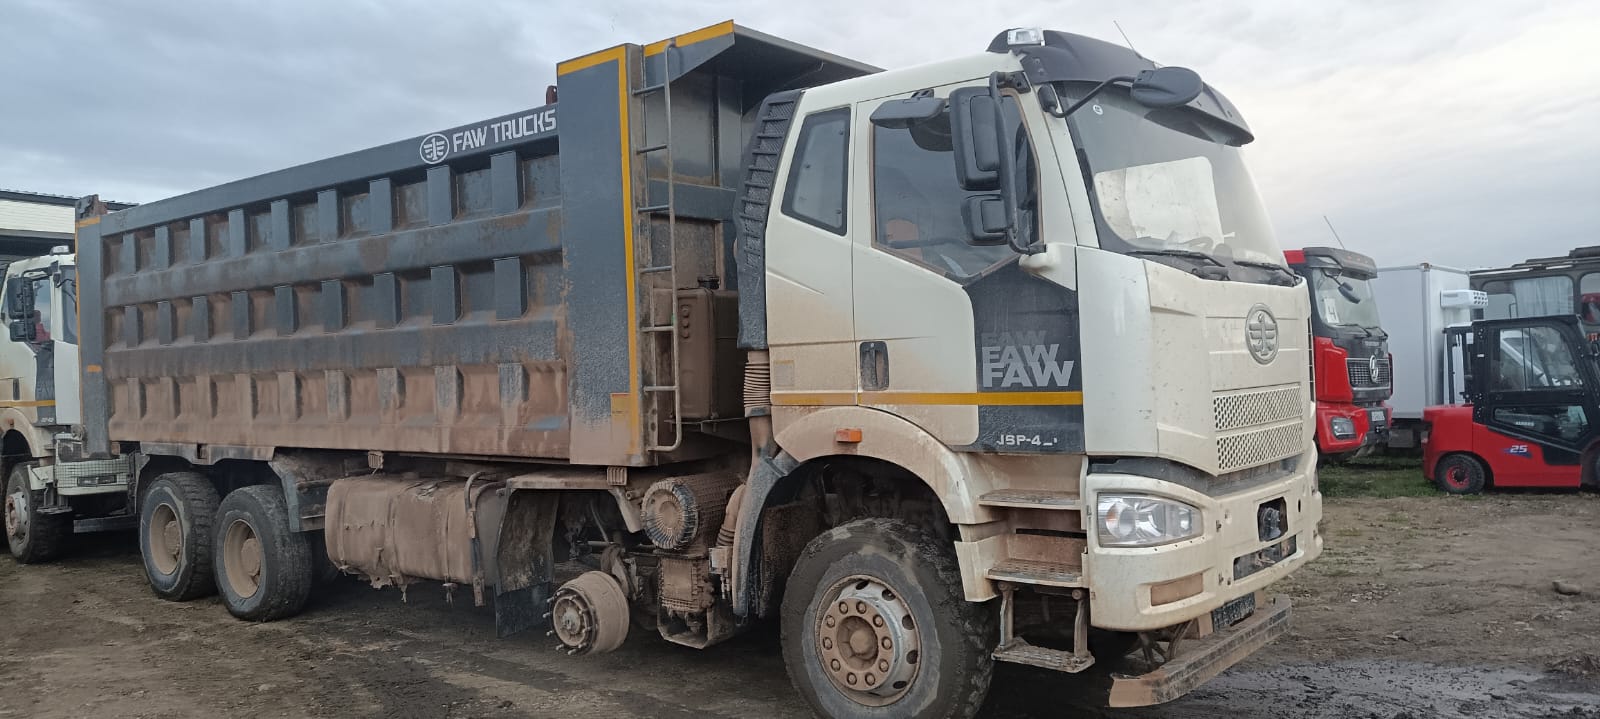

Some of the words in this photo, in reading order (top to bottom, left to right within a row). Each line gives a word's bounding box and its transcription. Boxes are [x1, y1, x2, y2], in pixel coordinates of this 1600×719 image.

[452, 125, 488, 153] FAW
[491, 108, 557, 143] TRUCKS
[982, 343, 1060, 366] FAW
[982, 360, 1075, 388] FAW
[1510, 444, 1529, 454] 25
